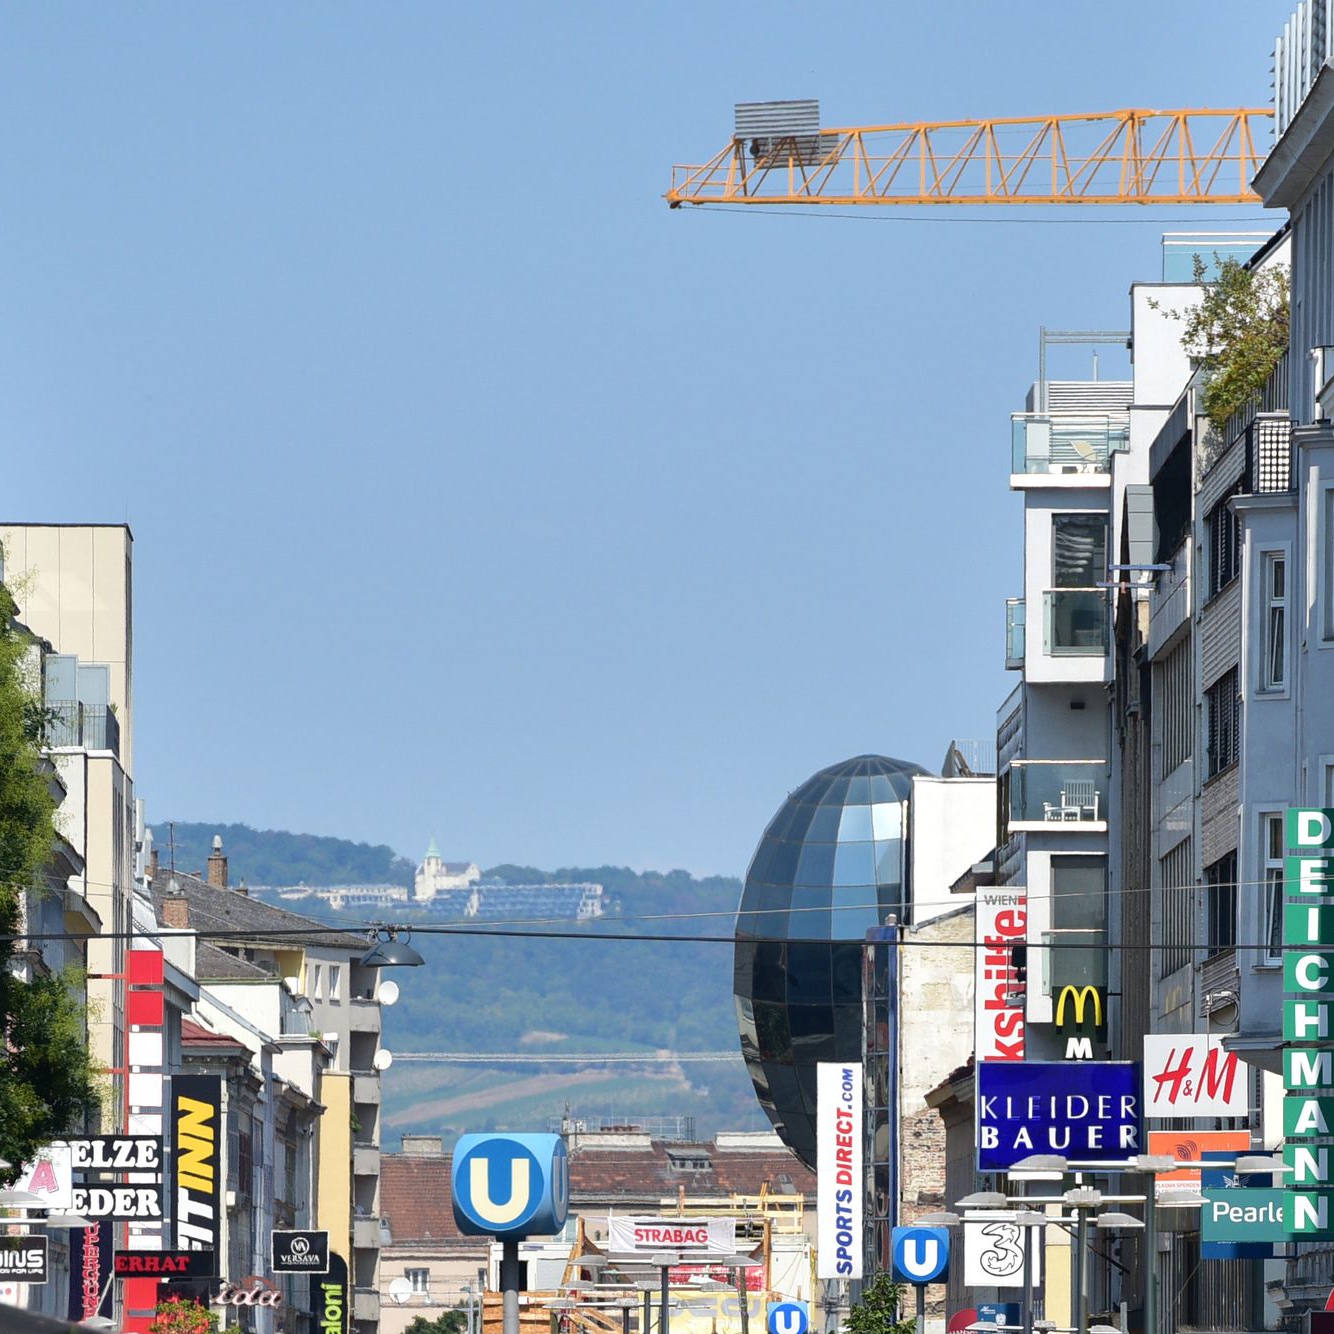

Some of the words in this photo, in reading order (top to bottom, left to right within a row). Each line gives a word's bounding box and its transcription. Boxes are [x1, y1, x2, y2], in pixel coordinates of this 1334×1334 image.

[1289, 811, 1333, 1230] DEICHMANN
[1152, 1046, 1238, 1105] H&M
[981, 1095, 1138, 1120] KLEIDER
[981, 1124, 1139, 1149] BAUER
[51, 1140, 160, 1168] ELZE
[45, 1188, 163, 1217] EDER
[470, 1157, 530, 1224] U
[634, 1228, 709, 1243] STRABAG
[280, 1254, 320, 1263] VERSAVA
[904, 1239, 938, 1277] U
